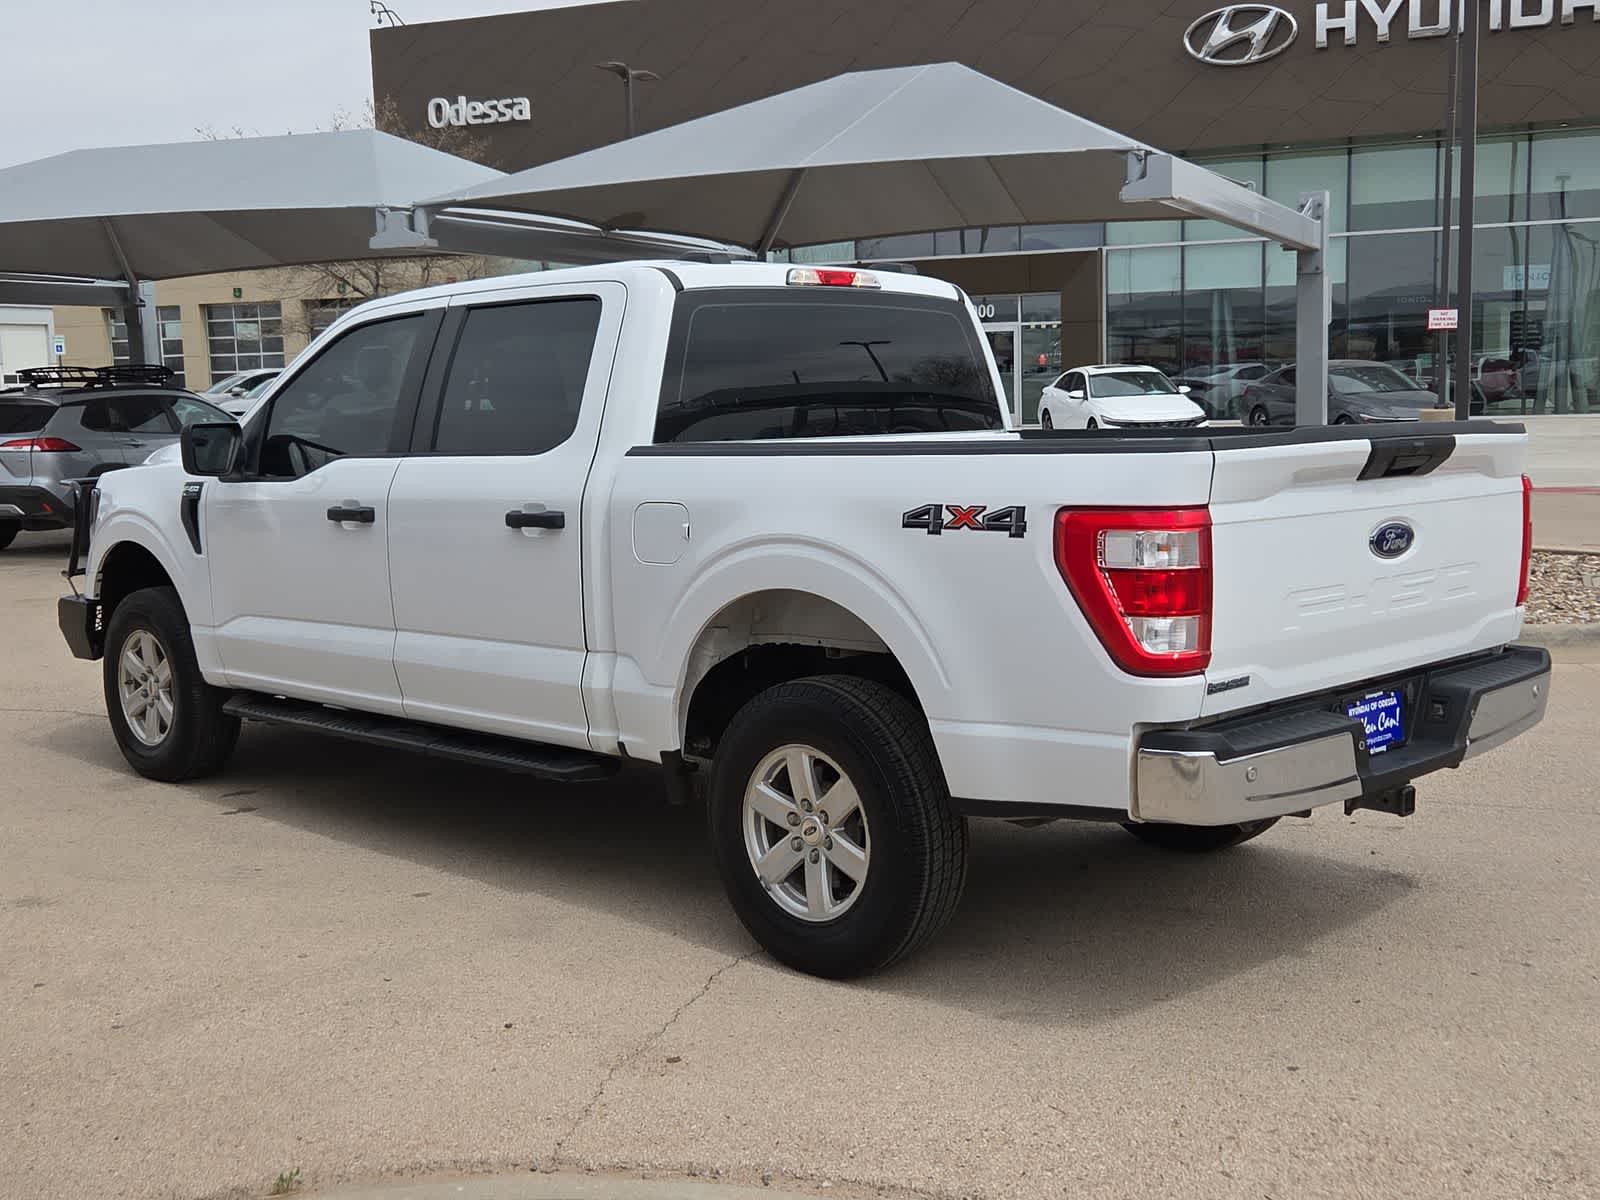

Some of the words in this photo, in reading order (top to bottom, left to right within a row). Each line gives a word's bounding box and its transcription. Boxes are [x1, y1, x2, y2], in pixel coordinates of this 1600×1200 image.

[428, 96, 531, 129] Odessa
[1382, 528, 1409, 551] Ford
[1370, 701, 1378, 711] OF
[1378, 706, 1400, 731] Can!
